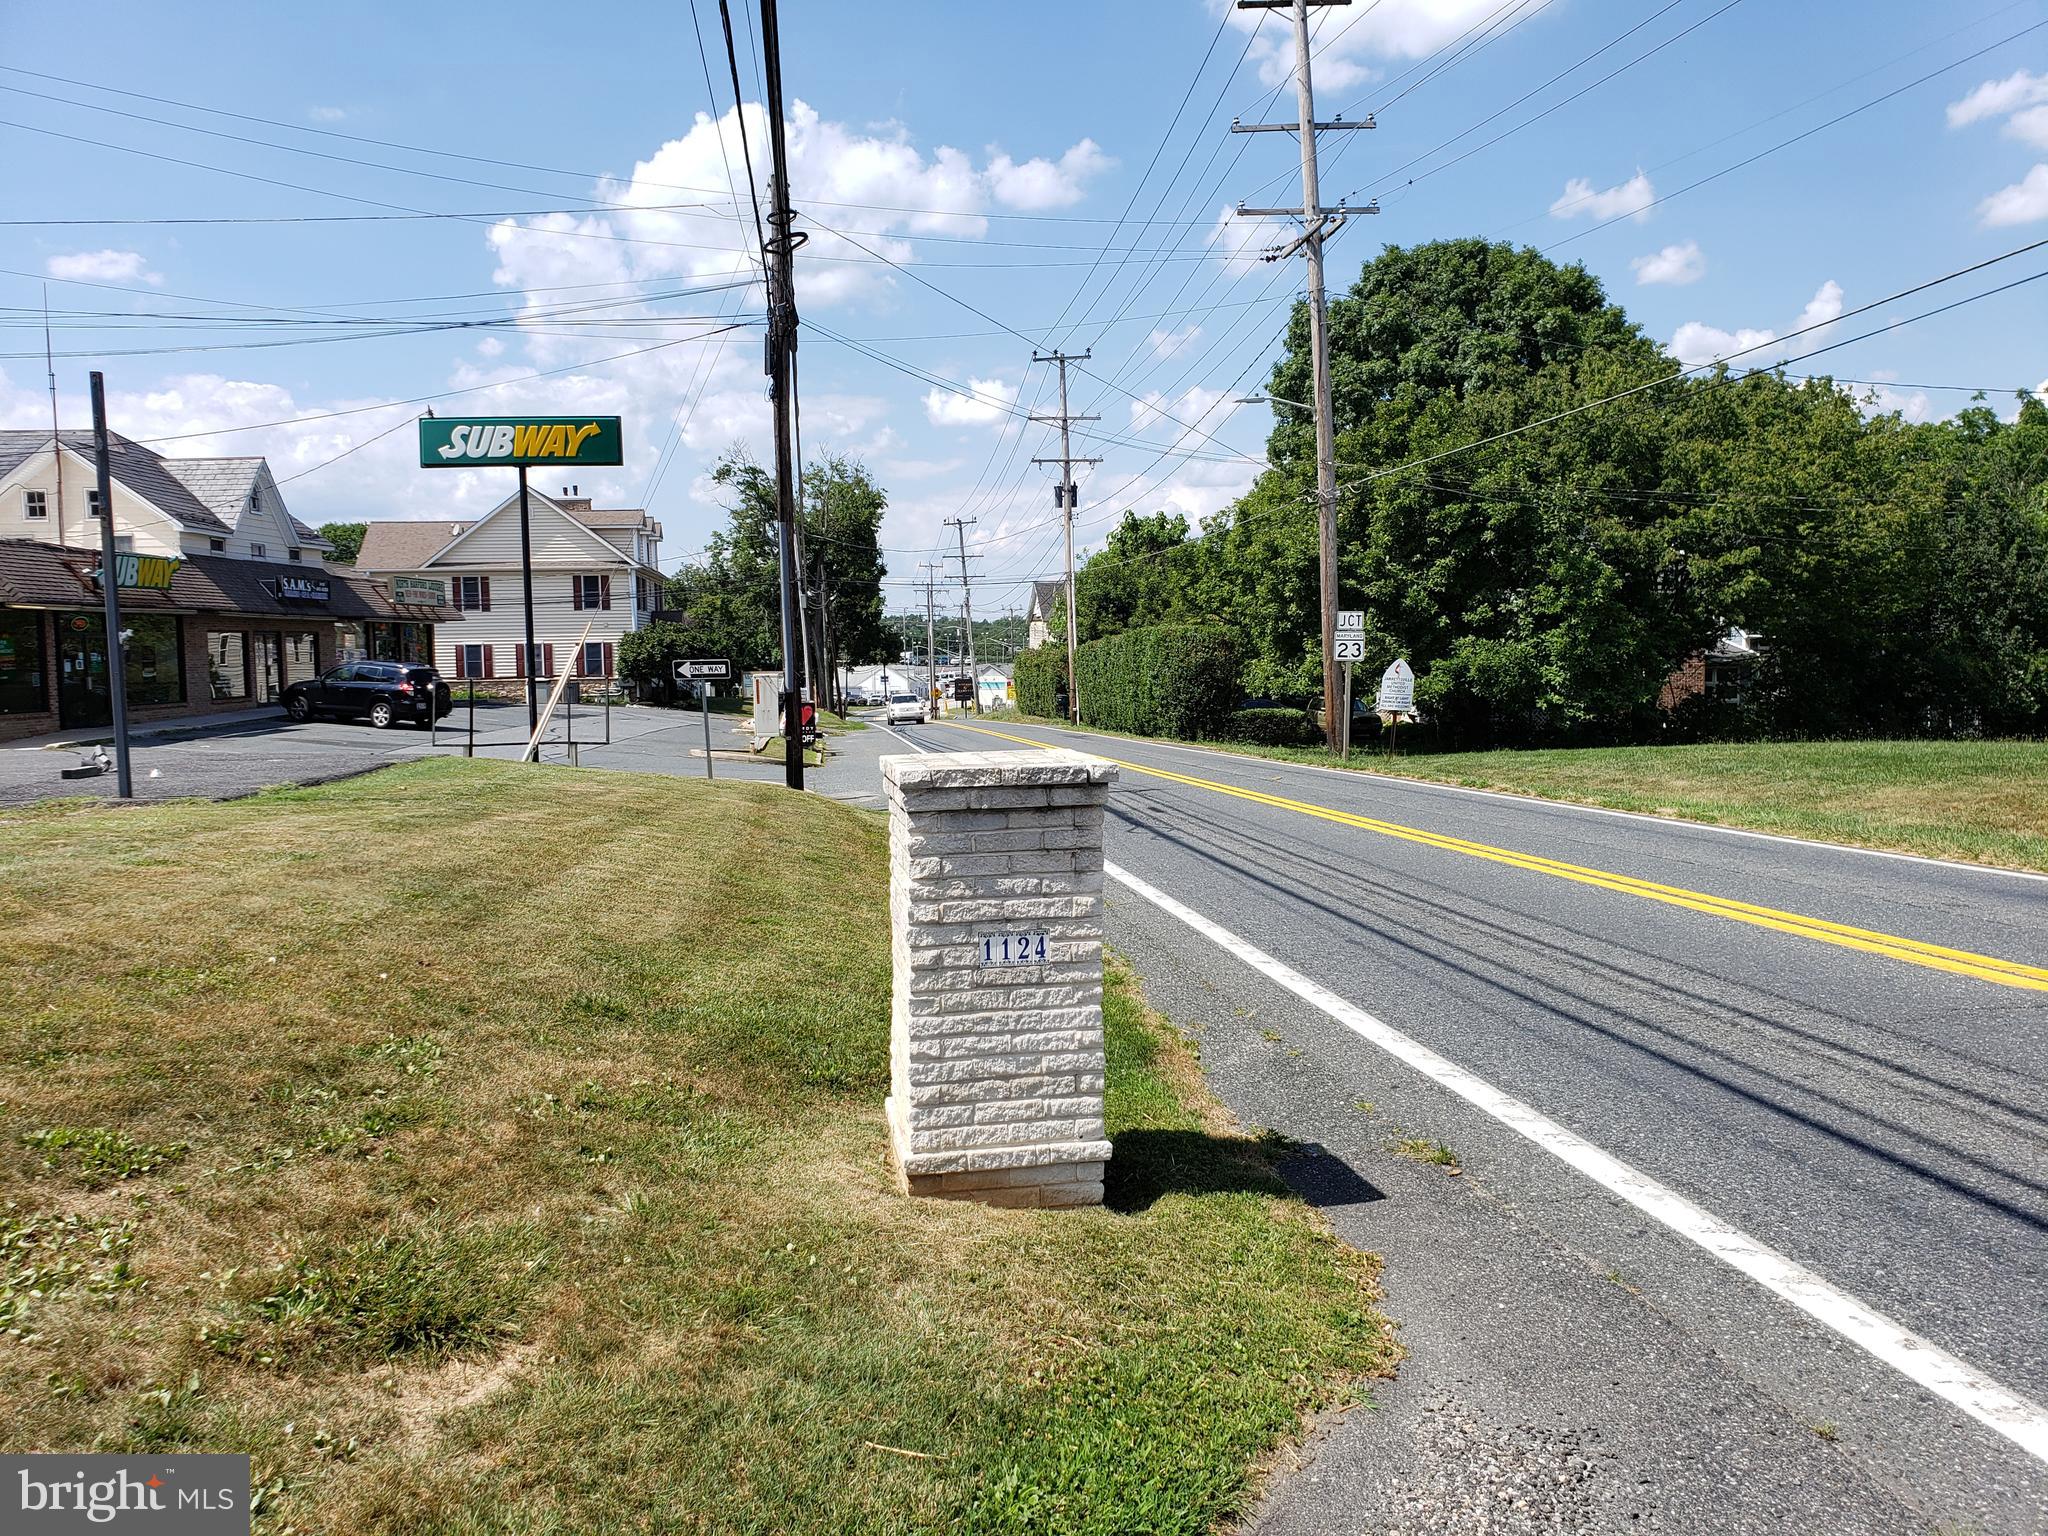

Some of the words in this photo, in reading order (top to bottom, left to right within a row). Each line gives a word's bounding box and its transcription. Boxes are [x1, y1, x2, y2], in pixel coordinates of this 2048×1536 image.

[438, 422, 602, 460] SUBWAY
[1340, 614, 1362, 627] JCT
[1337, 642, 1362, 658] 23
[689, 665, 705, 674] ONE
[708, 665, 723, 673] WAY
[802, 734, 815, 743] OFF
[983, 935, 1047, 961] 1124
